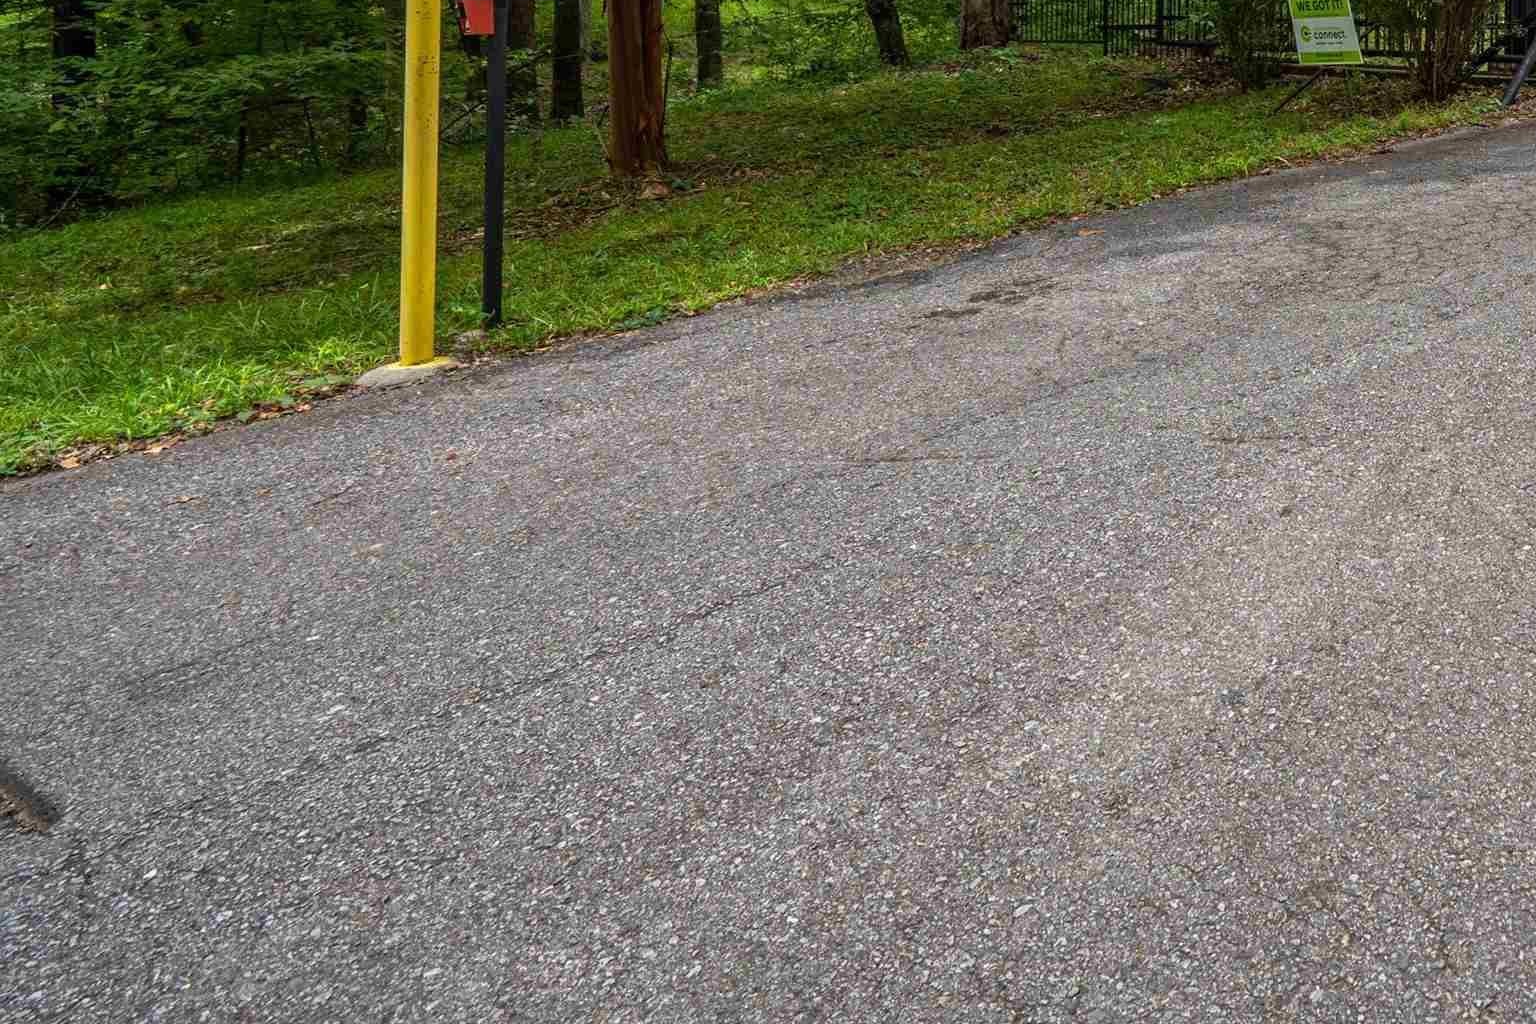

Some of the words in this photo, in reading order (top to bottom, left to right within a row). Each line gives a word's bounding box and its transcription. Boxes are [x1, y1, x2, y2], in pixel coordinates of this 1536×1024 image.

[1296, 0, 1311, 11] WE
[1312, 0, 1329, 10] GOT
[1332, 0, 1344, 9] IT!
[1313, 31, 1345, 40] connect
